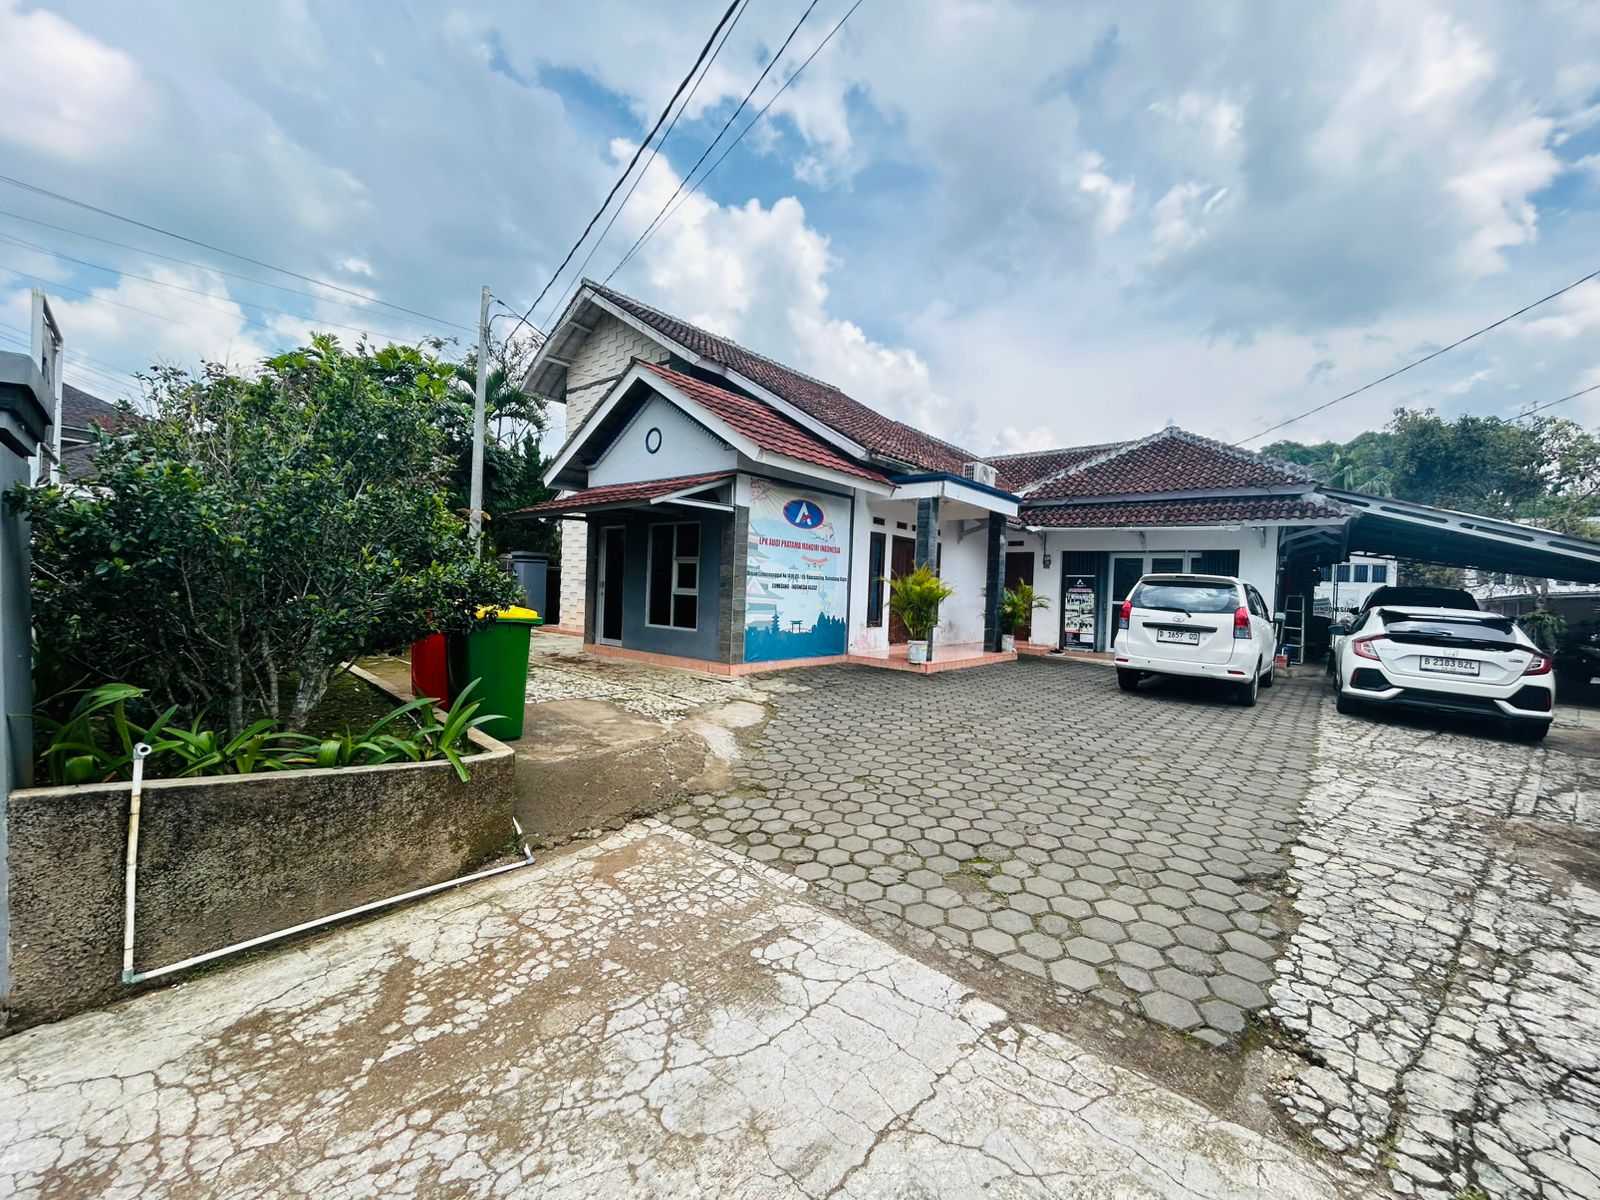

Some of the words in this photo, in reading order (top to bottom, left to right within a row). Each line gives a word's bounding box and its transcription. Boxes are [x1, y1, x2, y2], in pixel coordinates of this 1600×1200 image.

[759, 536, 768, 545] LPK
[769, 538, 780, 547] AUDI
[781, 539, 801, 550] PRATAMA
[802, 542, 819, 552] MANDIRI
[820, 544, 841, 554] INDONESIA
[1433, 658, 1456, 668] 2183
[1458, 660, 1475, 670] BZL
